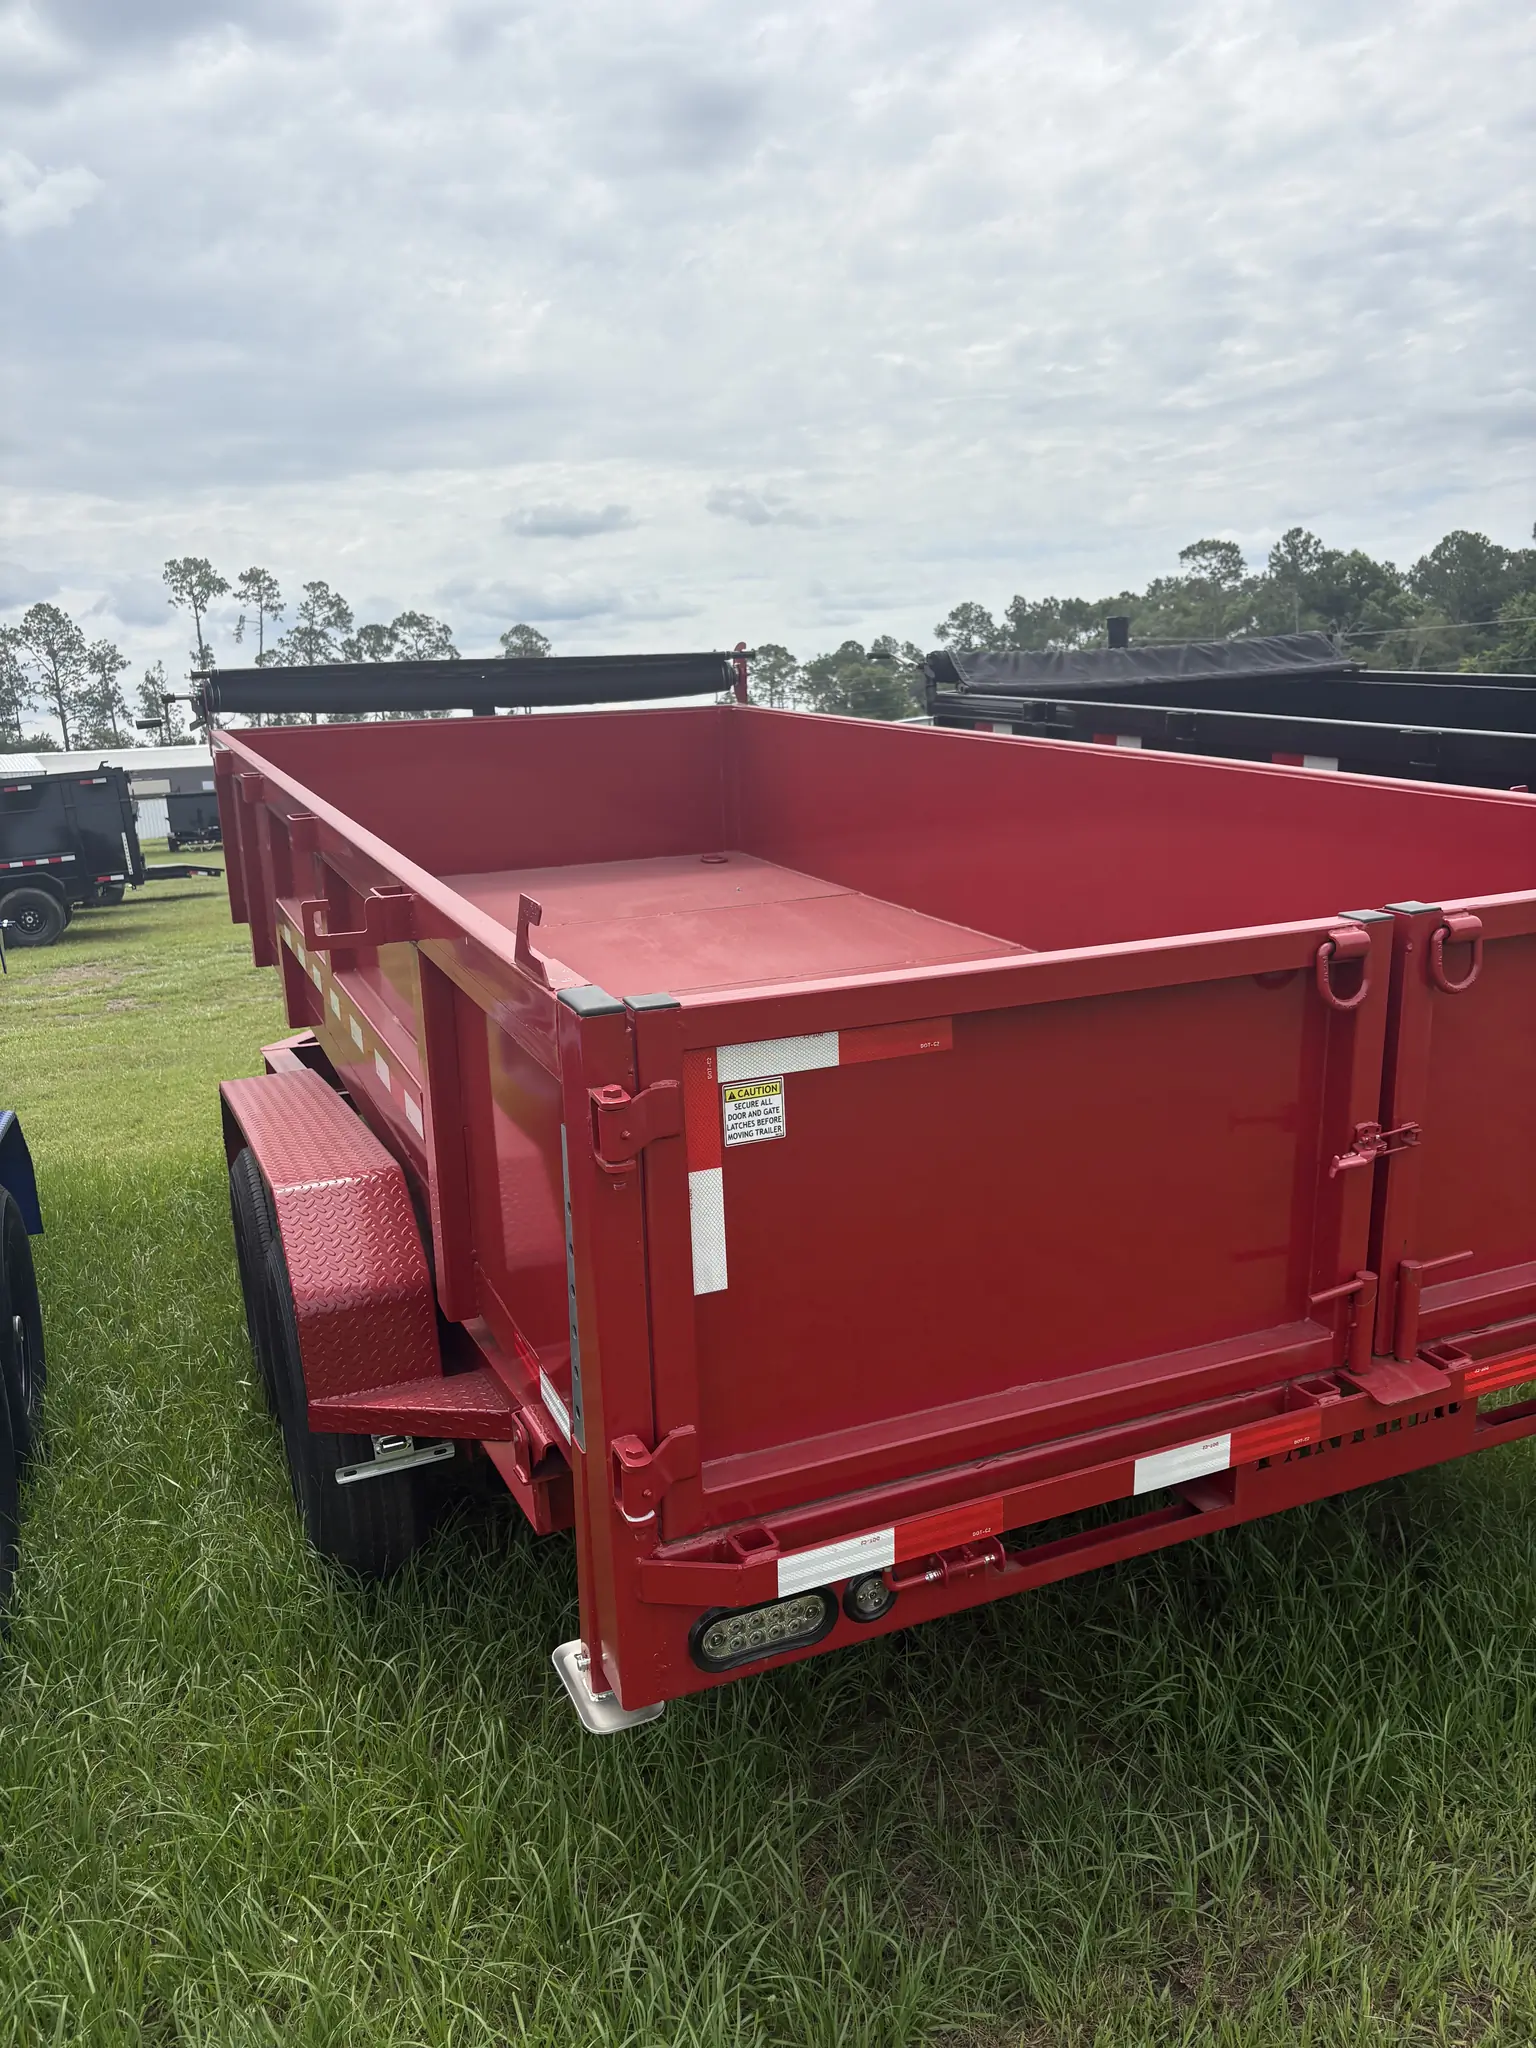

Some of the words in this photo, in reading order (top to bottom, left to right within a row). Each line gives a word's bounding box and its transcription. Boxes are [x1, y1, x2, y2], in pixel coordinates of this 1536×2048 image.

[737, 1083, 778, 1098] CAUTION
[734, 1100, 759, 1111] SECURE
[760, 1098, 773, 1107] ALL
[727, 1111, 747, 1122] DOOR
[748, 1109, 762, 1118] AND
[764, 1106, 780, 1115] GATE
[726, 1120, 756, 1131] LATCHES
[756, 1115, 782, 1126] BEFORE
[727, 1129, 754, 1141] MOVING
[755, 1125, 782, 1136] TRAILER
